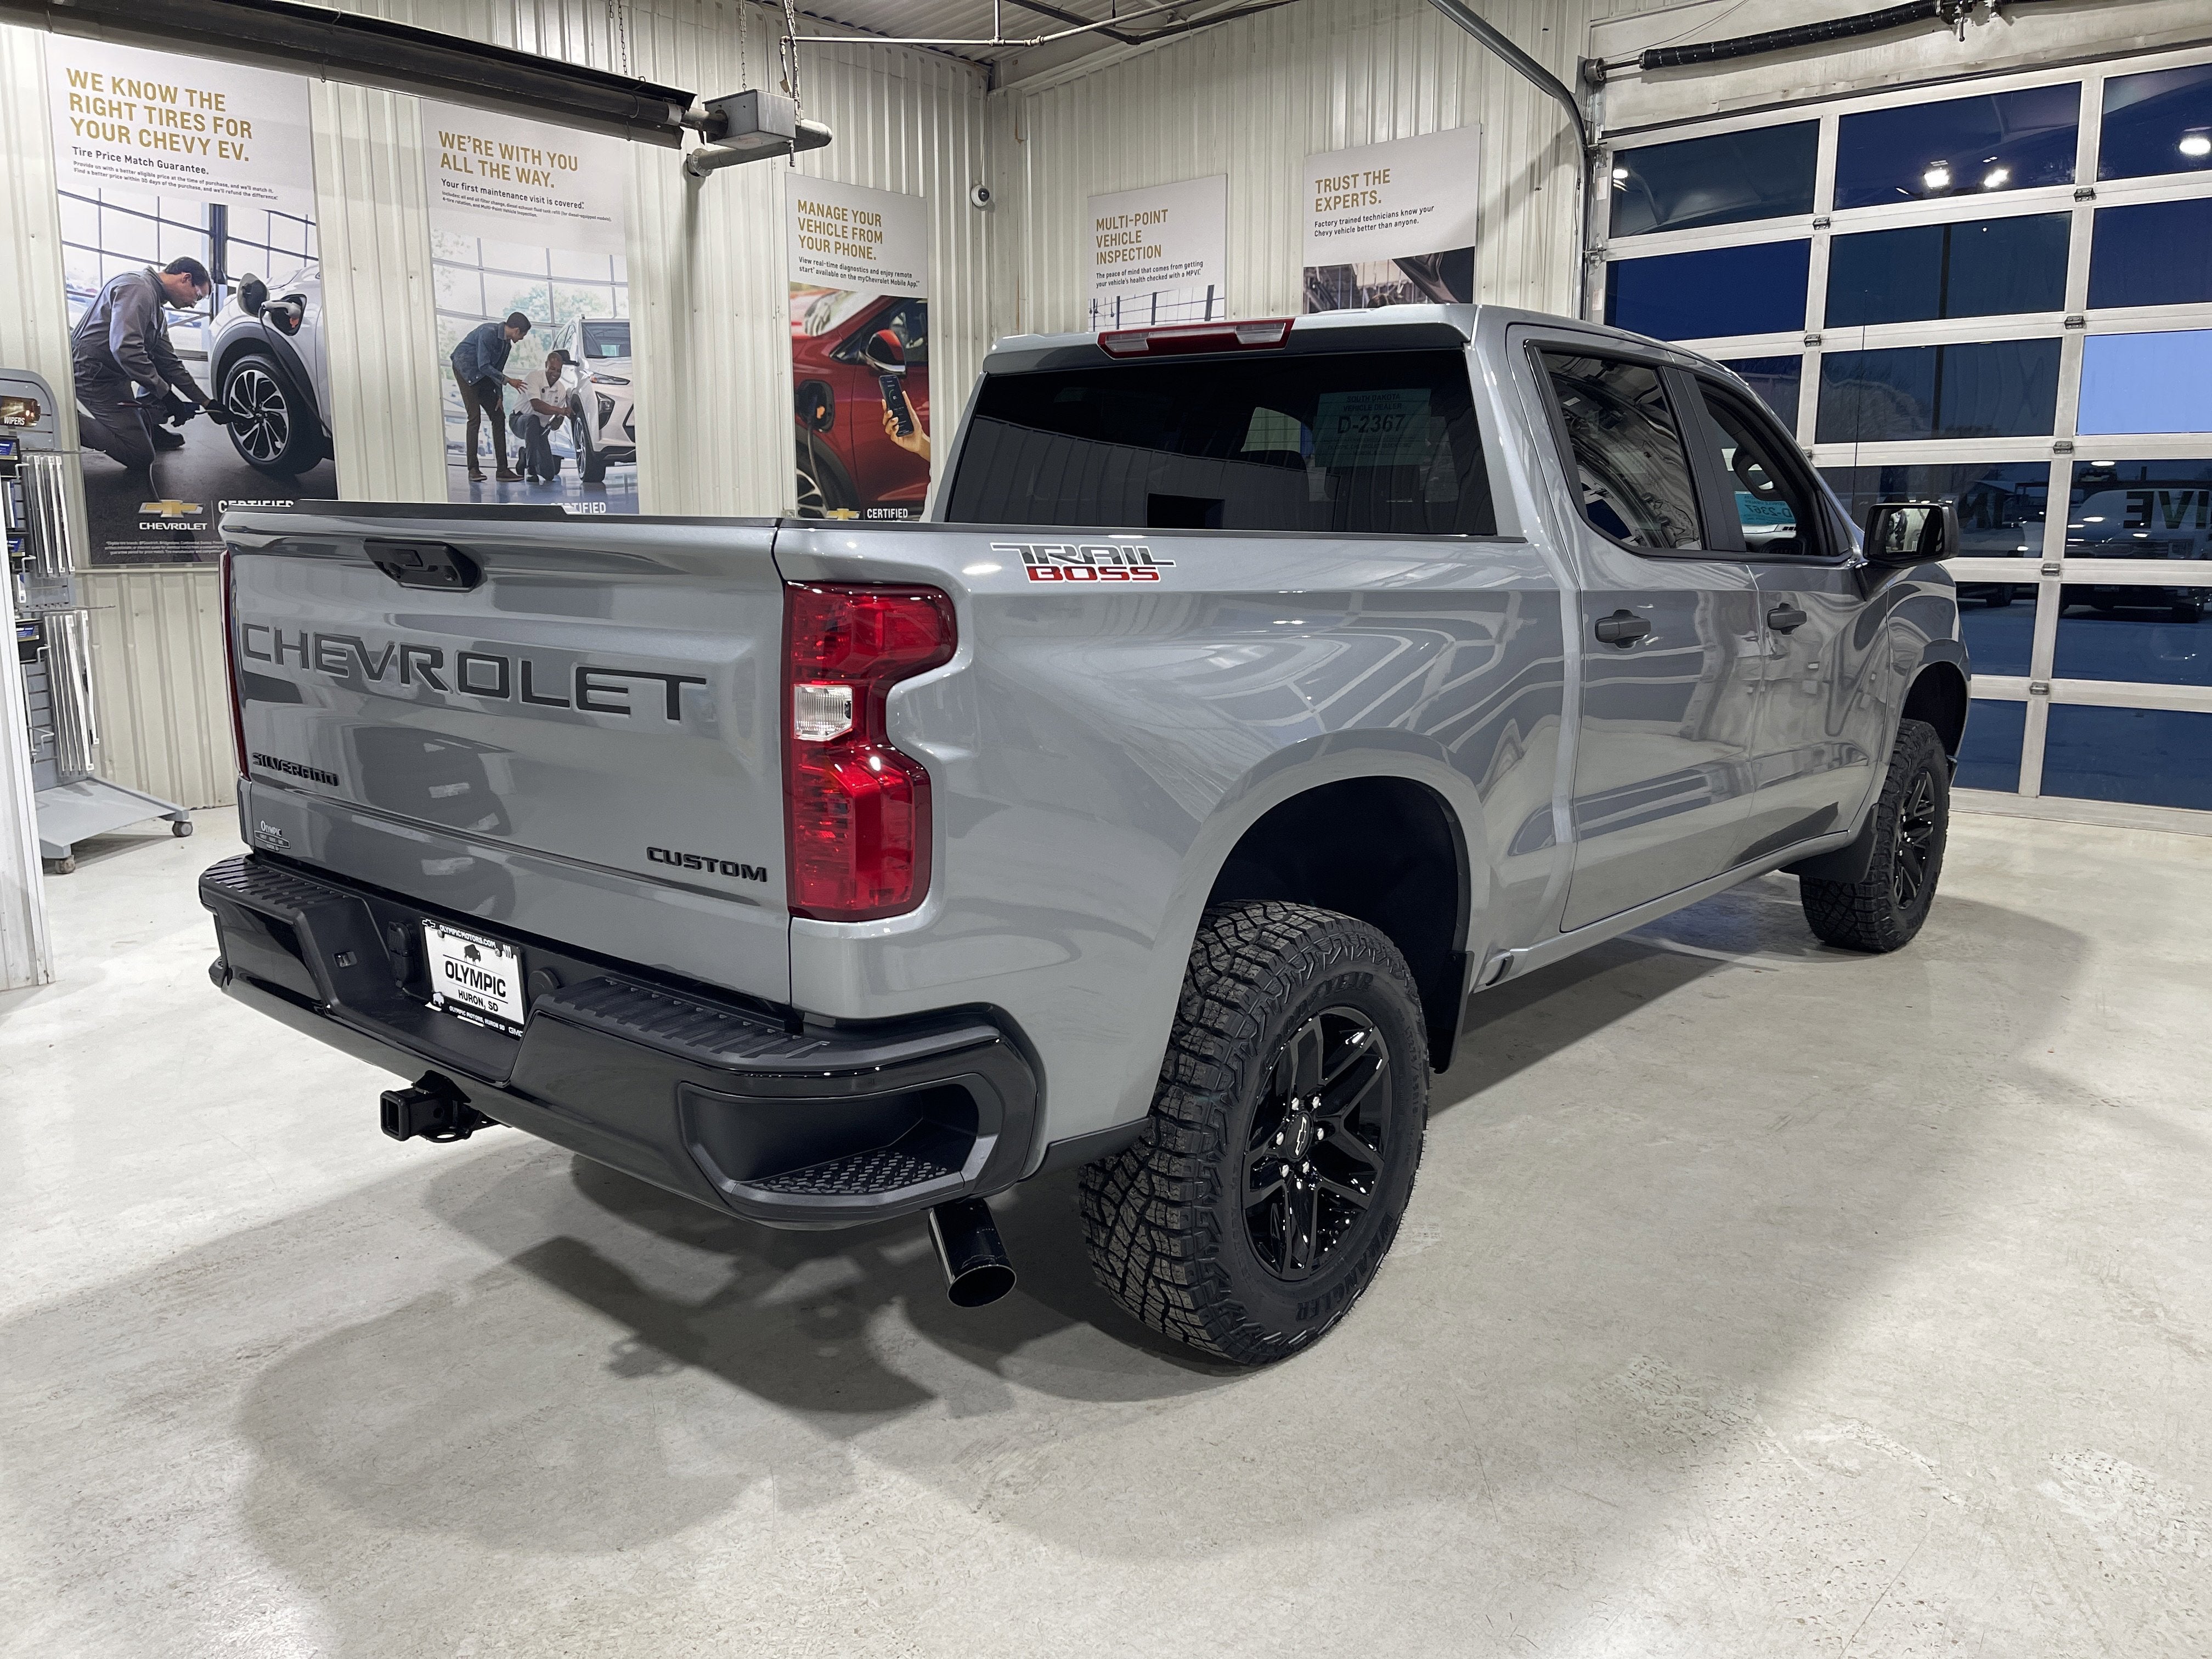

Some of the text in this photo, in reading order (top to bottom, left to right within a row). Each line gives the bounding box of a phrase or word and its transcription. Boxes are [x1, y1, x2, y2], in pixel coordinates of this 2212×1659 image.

[66, 68, 225, 111] WE KNOW THE
[69, 93, 252, 139] RIGHT TIRES FOR
[70, 117, 249, 161] YOUR CHEVY EV.
[72, 146, 209, 174] Tire Price Match Guarantee.
[499, 143, 541, 166] WITH
[546, 151, 578, 171] YOU
[440, 153, 555, 188] ALL THE WAY.
[1315, 168, 1391, 194] TRUST THE
[441, 178, 459, 189] Your
[461, 183, 478, 193] first
[481, 187, 528, 201] maintenance
[529, 195, 545, 204] visit
[1316, 190, 1381, 212] EXPERTS.
[798, 199, 882, 227] MANAGE YOUR
[1096, 209, 1168, 232] MULTI-POINT
[1339, 216, 1361, 225] trained
[1363, 211, 1399, 222] technicians
[1419, 205, 1434, 215] your
[1394, 218, 1419, 228] anyone.
[798, 217, 883, 244] VEHICLE FROM
[1096, 230, 1142, 247] VEHICLE
[798, 234, 877, 261] YOUR PHONE.
[1097, 244, 1161, 264] INSPECTION
[799, 256, 811, 264] View
[813, 259, 838, 269] real-time
[839, 263, 868, 274] diagnostics
[1184, 261, 1203, 269] getting
[816, 269, 839, 278] available
[858, 276, 889, 284] myChevrolet
[890, 278, 906, 286] Mobile
[1372, 393, 1400, 402] DAKOTA
[4, 416, 25, 426] WIPERS
[1338, 414, 1406, 434] D-2367
[550, 502, 606, 514] TIFIED
[867, 508, 908, 518] CERTIFIED
[139, 522, 208, 531] CHEVROLET
[990, 543, 1176, 567] TRAIL
[1025, 566, 1161, 583] BOSS
[240, 622, 708, 723] CHEVROLET
[252, 752, 340, 786] SILVERADO
[646, 847, 768, 882] CUSTOM
[439, 925, 496, 948] OLYMPICMOTORS.COM
[445, 961, 506, 997] OLYMPIC
[458, 990, 498, 1012] HURON, SD
[449, 1006, 466, 1016] OLYMPIC
[484, 1019, 499, 1029] HURON
[509, 1026, 523, 1037] GMC
[1296, 1211, 1394, 1322] WRANGLER
